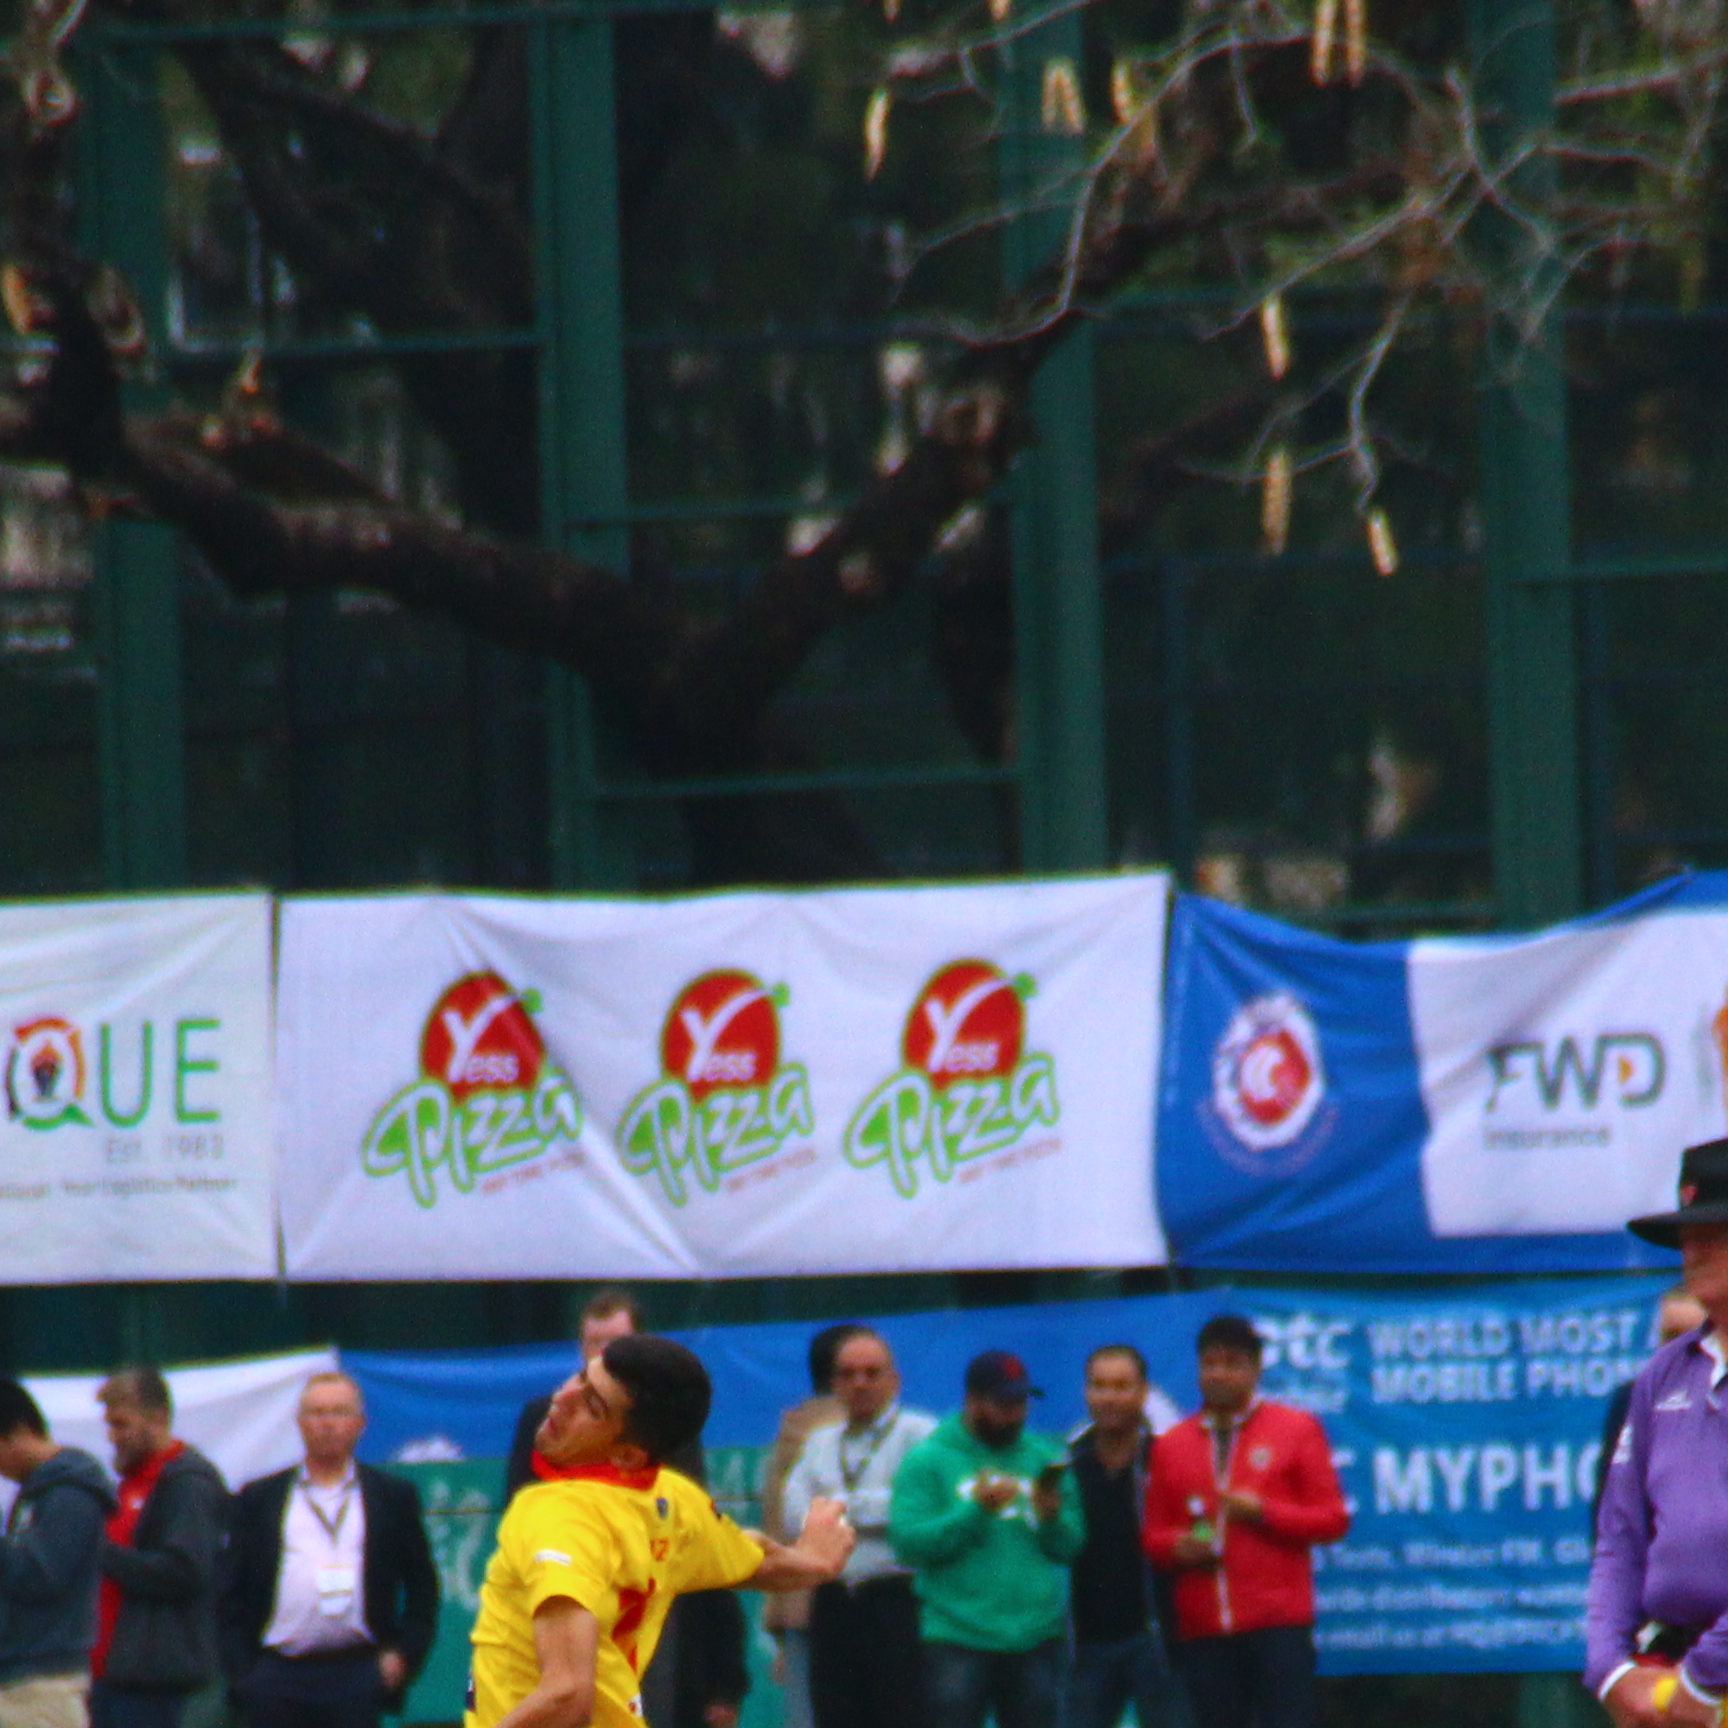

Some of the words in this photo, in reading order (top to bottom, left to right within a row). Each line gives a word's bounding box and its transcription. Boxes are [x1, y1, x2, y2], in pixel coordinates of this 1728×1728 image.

[843, 1052, 1061, 1199] Pizza
[1483, 1032, 1668, 1113] FWD
[362, 1066, 584, 1208] Pizza
[616, 1062, 815, 1208] Pizza
[1368, 1312, 1512, 1359] WORLD
[1521, 1309, 1639, 1354] MOST
[1371, 1359, 1518, 1402] MOBILE
